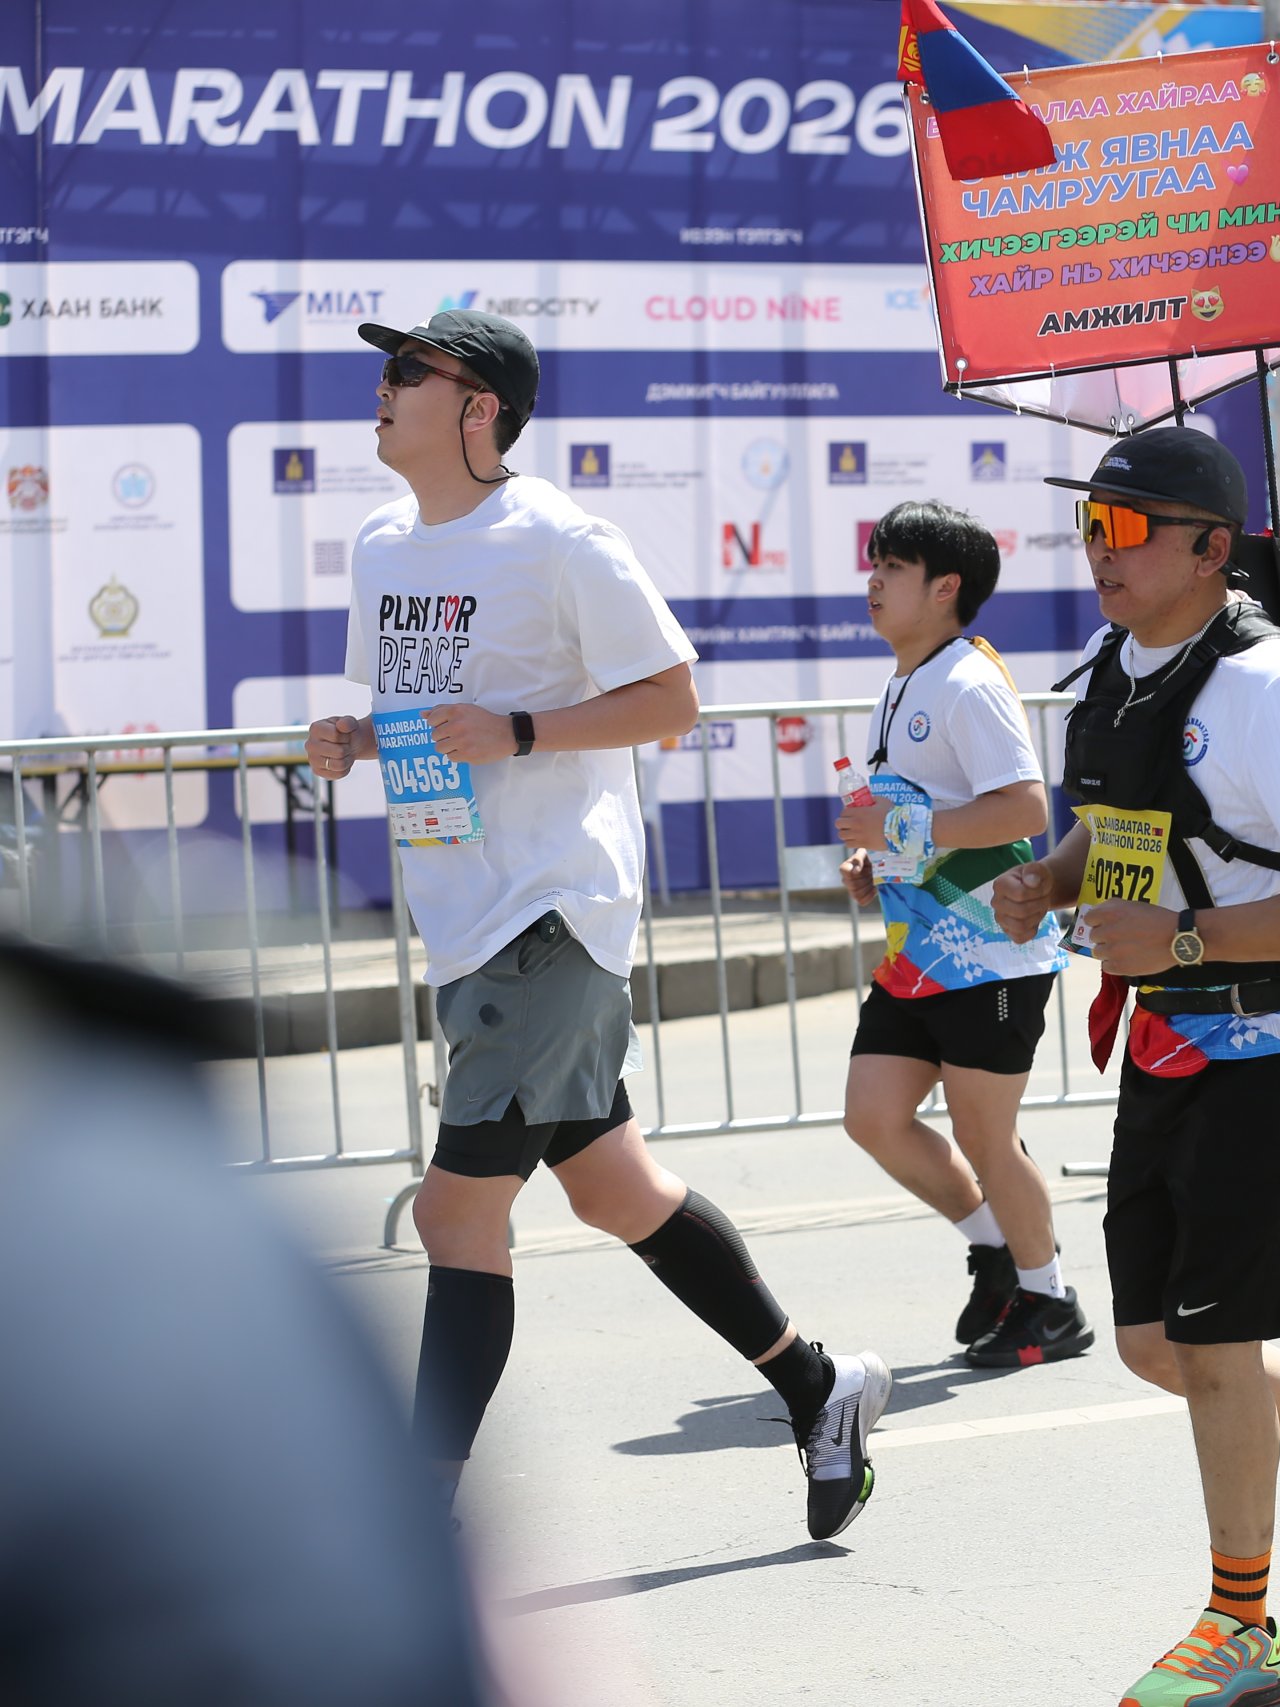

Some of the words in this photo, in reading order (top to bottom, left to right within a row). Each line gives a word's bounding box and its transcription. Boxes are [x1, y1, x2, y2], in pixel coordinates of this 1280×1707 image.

[0, 66, 632, 149] MARATHON
[650, 76, 912, 157] 2026
[1116, 80, 1241, 115] ХАЙРАА
[1101, 121, 1254, 168] ЯВНАА
[962, 162, 1216, 219] ЧАМРУУГАА
[939, 211, 1159, 264] ХИЧЭЭГЭЭРЭЙ
[1167, 210, 1210, 235] ЧИ
[969, 264, 1054, 298] ХАЙР
[1061, 262, 1103, 286] НЬ
[1108, 240, 1267, 280] ХИЧЭЭНЭЭ
[22, 298, 91, 320] ХААН
[99, 298, 164, 320] БАНК
[306, 290, 385, 315] MIAT
[487, 298, 600, 317] NEOCITY
[644, 296, 757, 321] CLOUD
[1037, 296, 1187, 337] АМЖИЛТ
[380, 594, 431, 632] PLAY
[378, 636, 469, 694] PEACE
[376, 718, 432, 736] ULAANBAAT
[379, 732, 429, 750] MARATHON
[387, 754, 461, 795] 04563
[899, 793, 925, 803] 2026
[1136, 837, 1162, 853] 2026
[1095, 857, 1155, 902] 07372
